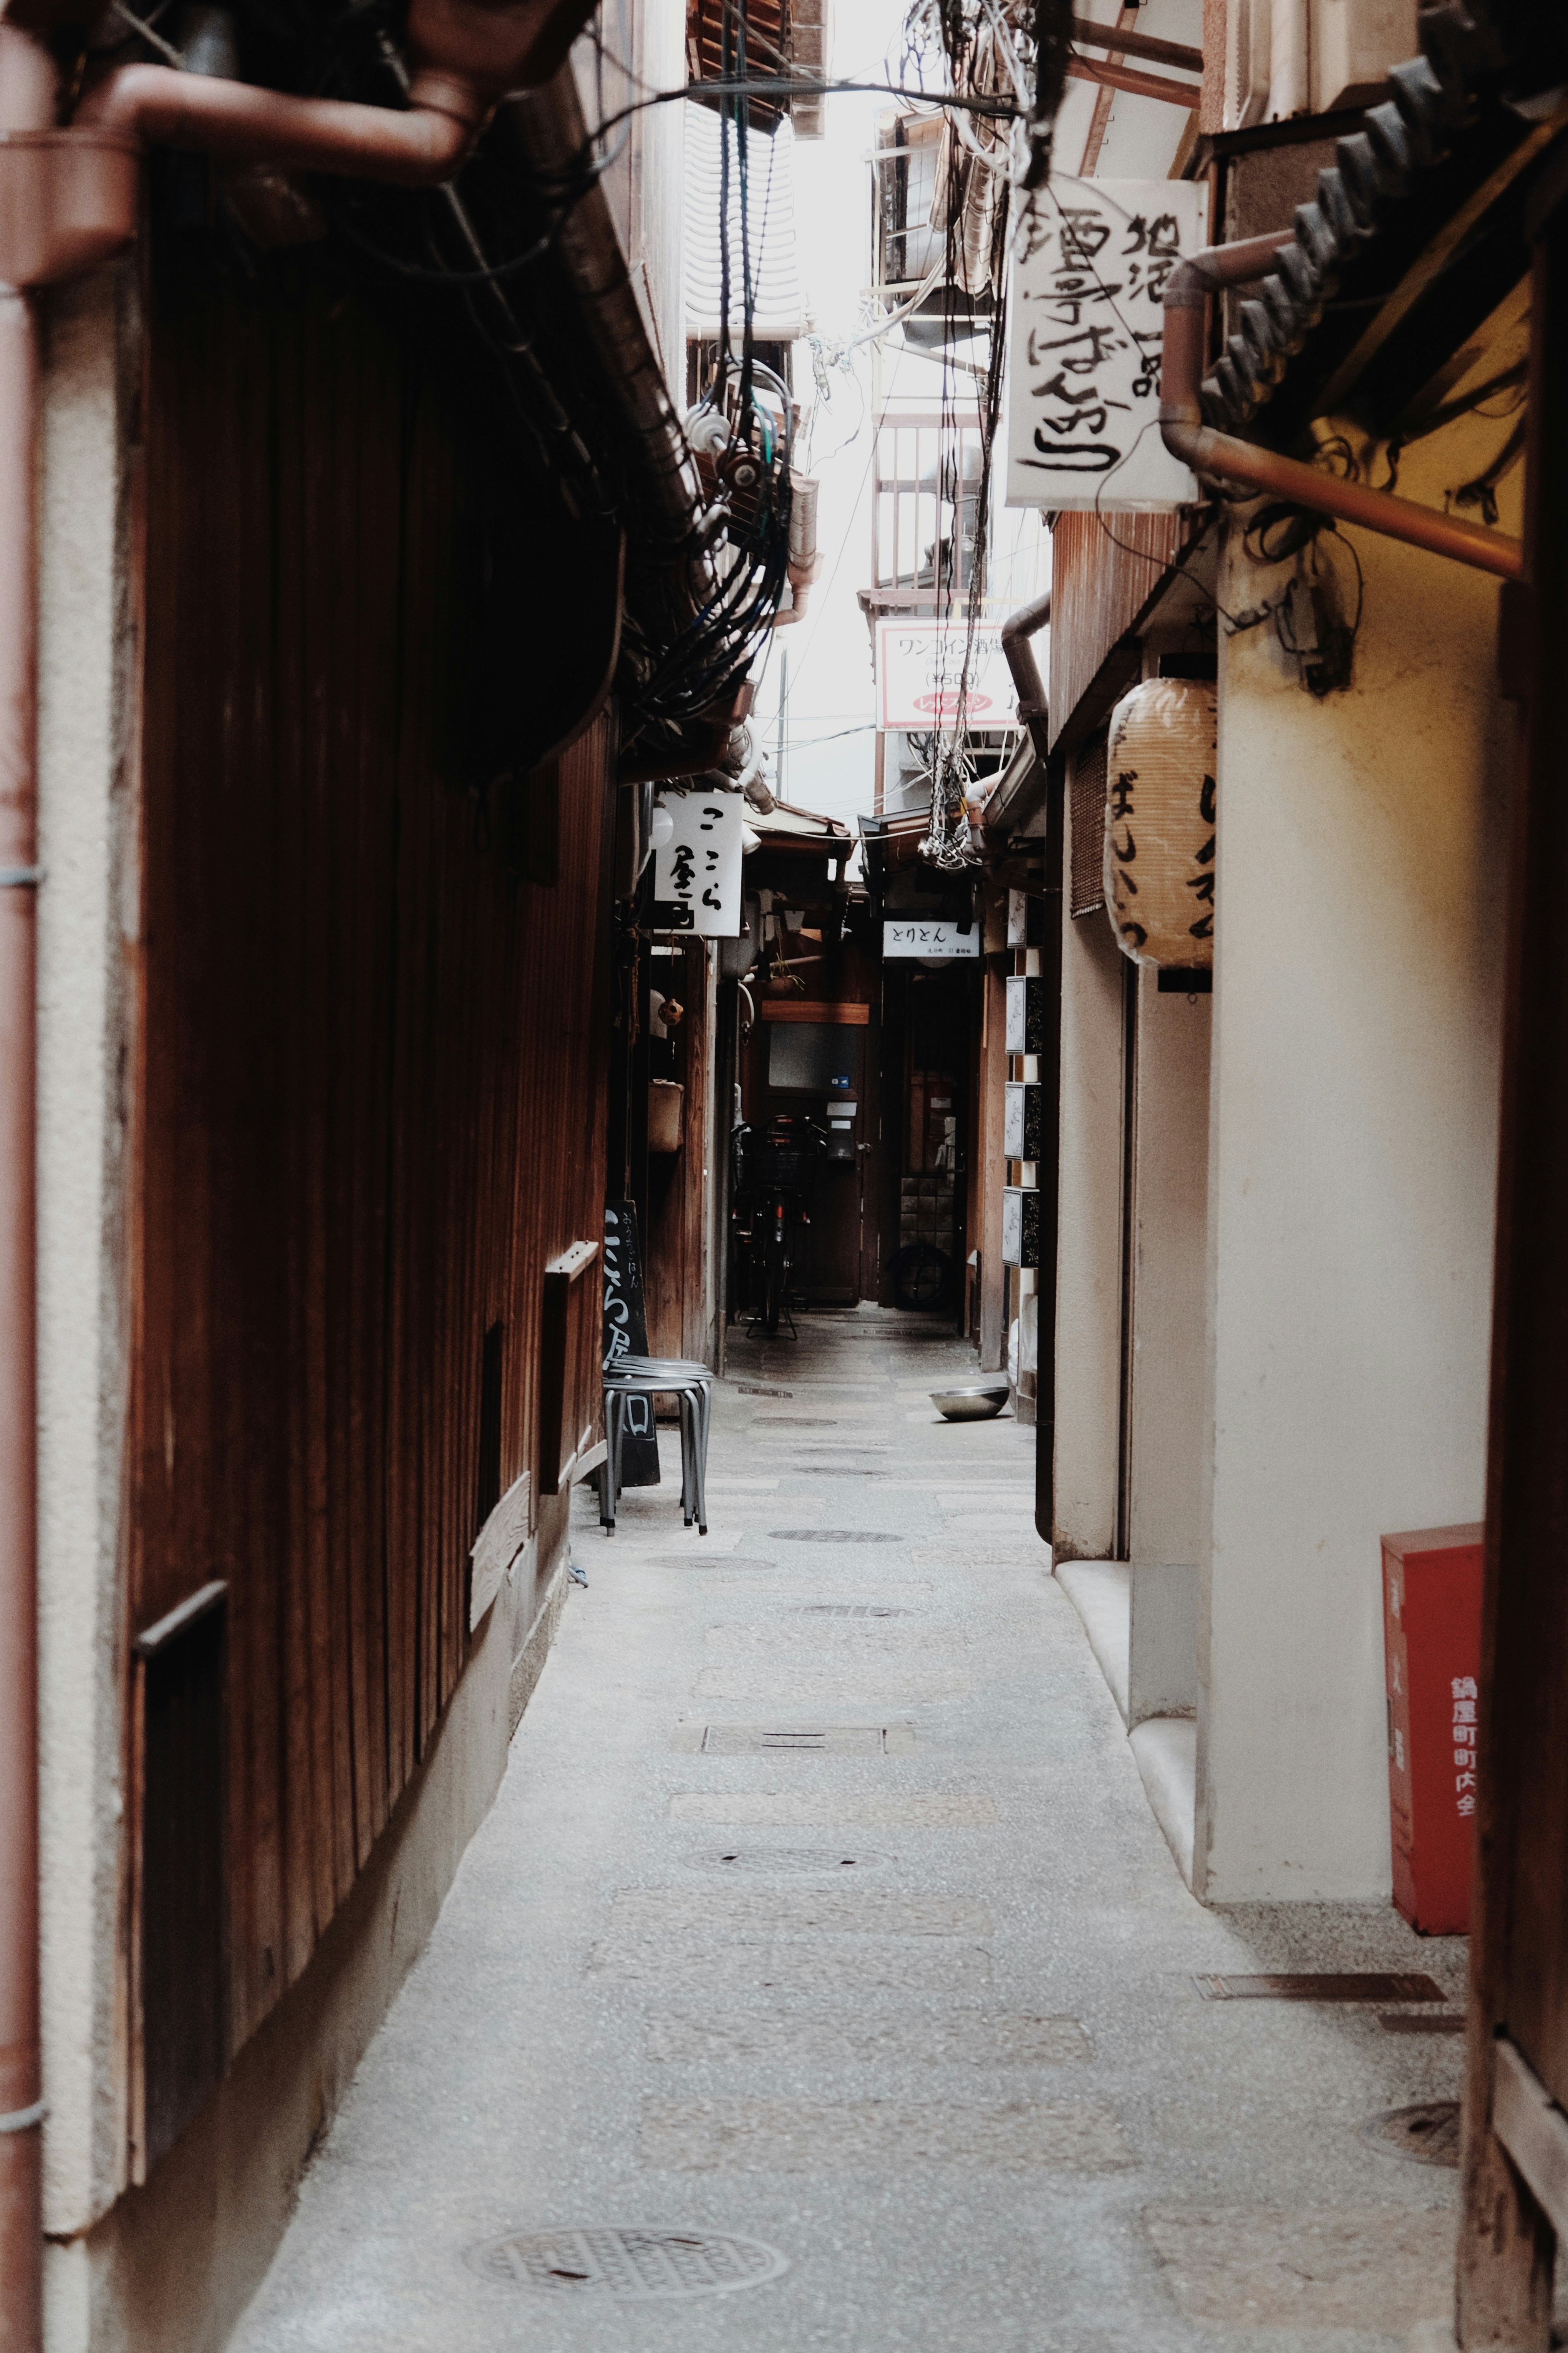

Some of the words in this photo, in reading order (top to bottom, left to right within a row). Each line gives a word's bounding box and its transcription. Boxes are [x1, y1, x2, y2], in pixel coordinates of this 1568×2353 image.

[900, 639, 1003, 655] ワンコイン酒場
[700, 808, 723, 911] ここら
[893, 928, 946, 943] とりとん
